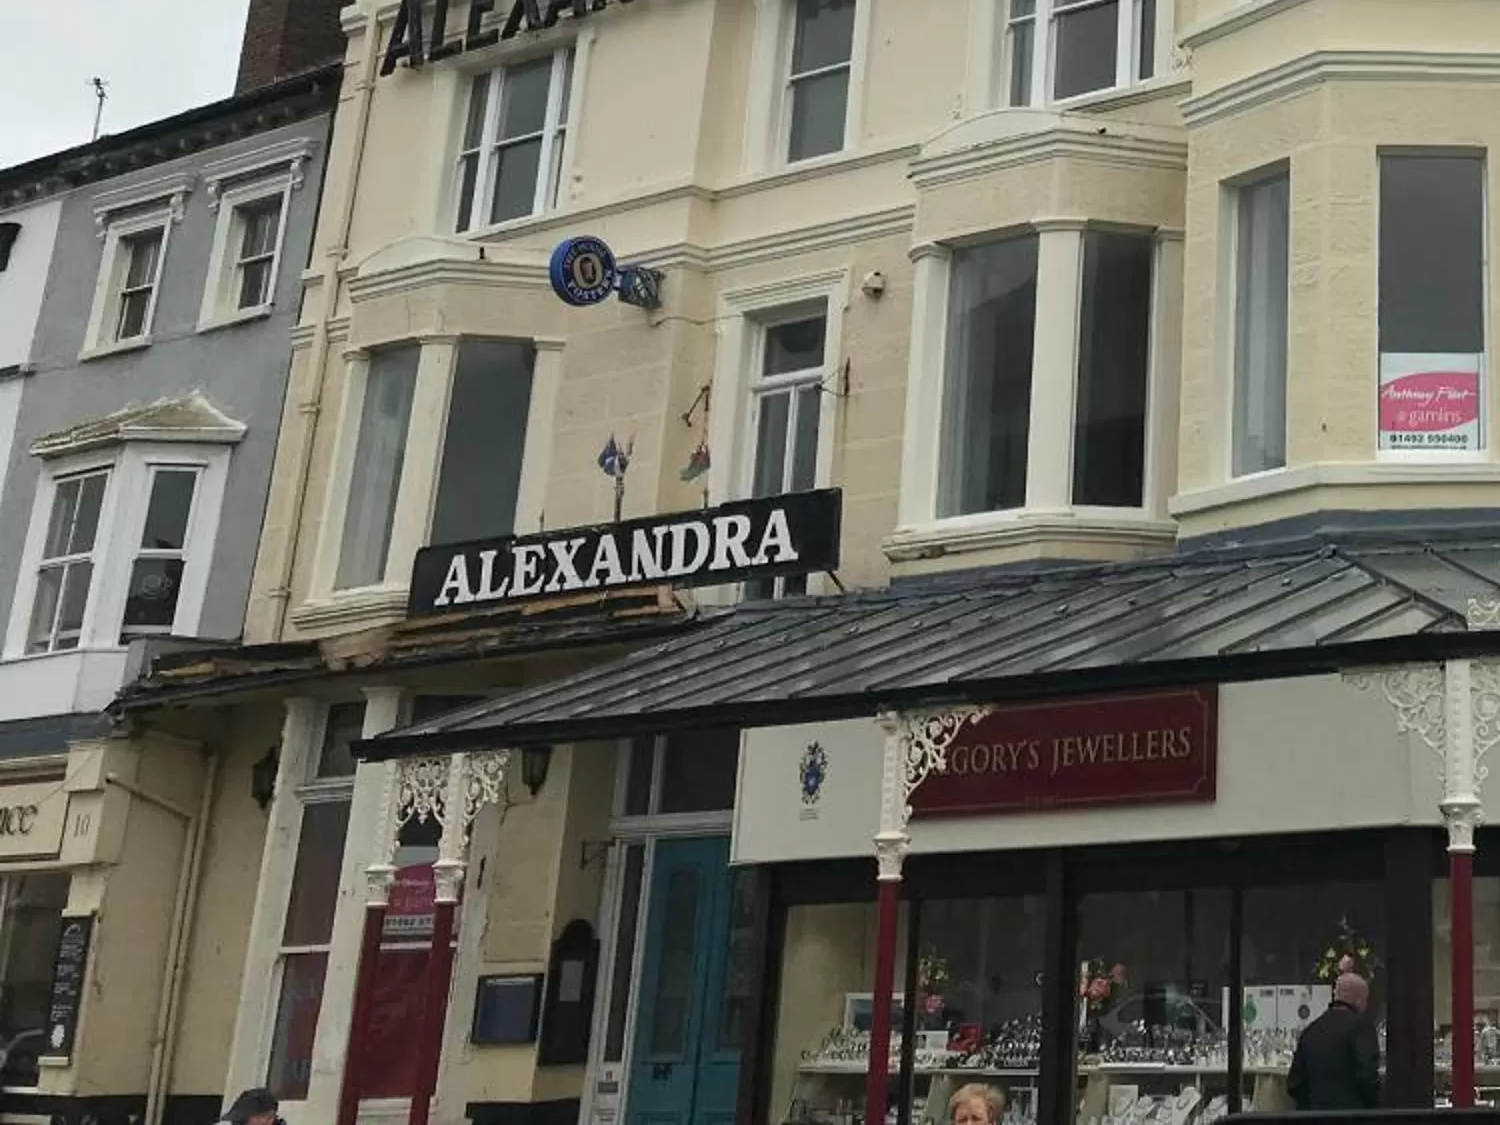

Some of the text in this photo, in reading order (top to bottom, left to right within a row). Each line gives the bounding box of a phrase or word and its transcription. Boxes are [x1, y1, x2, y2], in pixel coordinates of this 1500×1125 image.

[434, 508, 798, 607] ALEXANDRA
[932, 727, 1191, 776] GORY'S JEWELLERS
